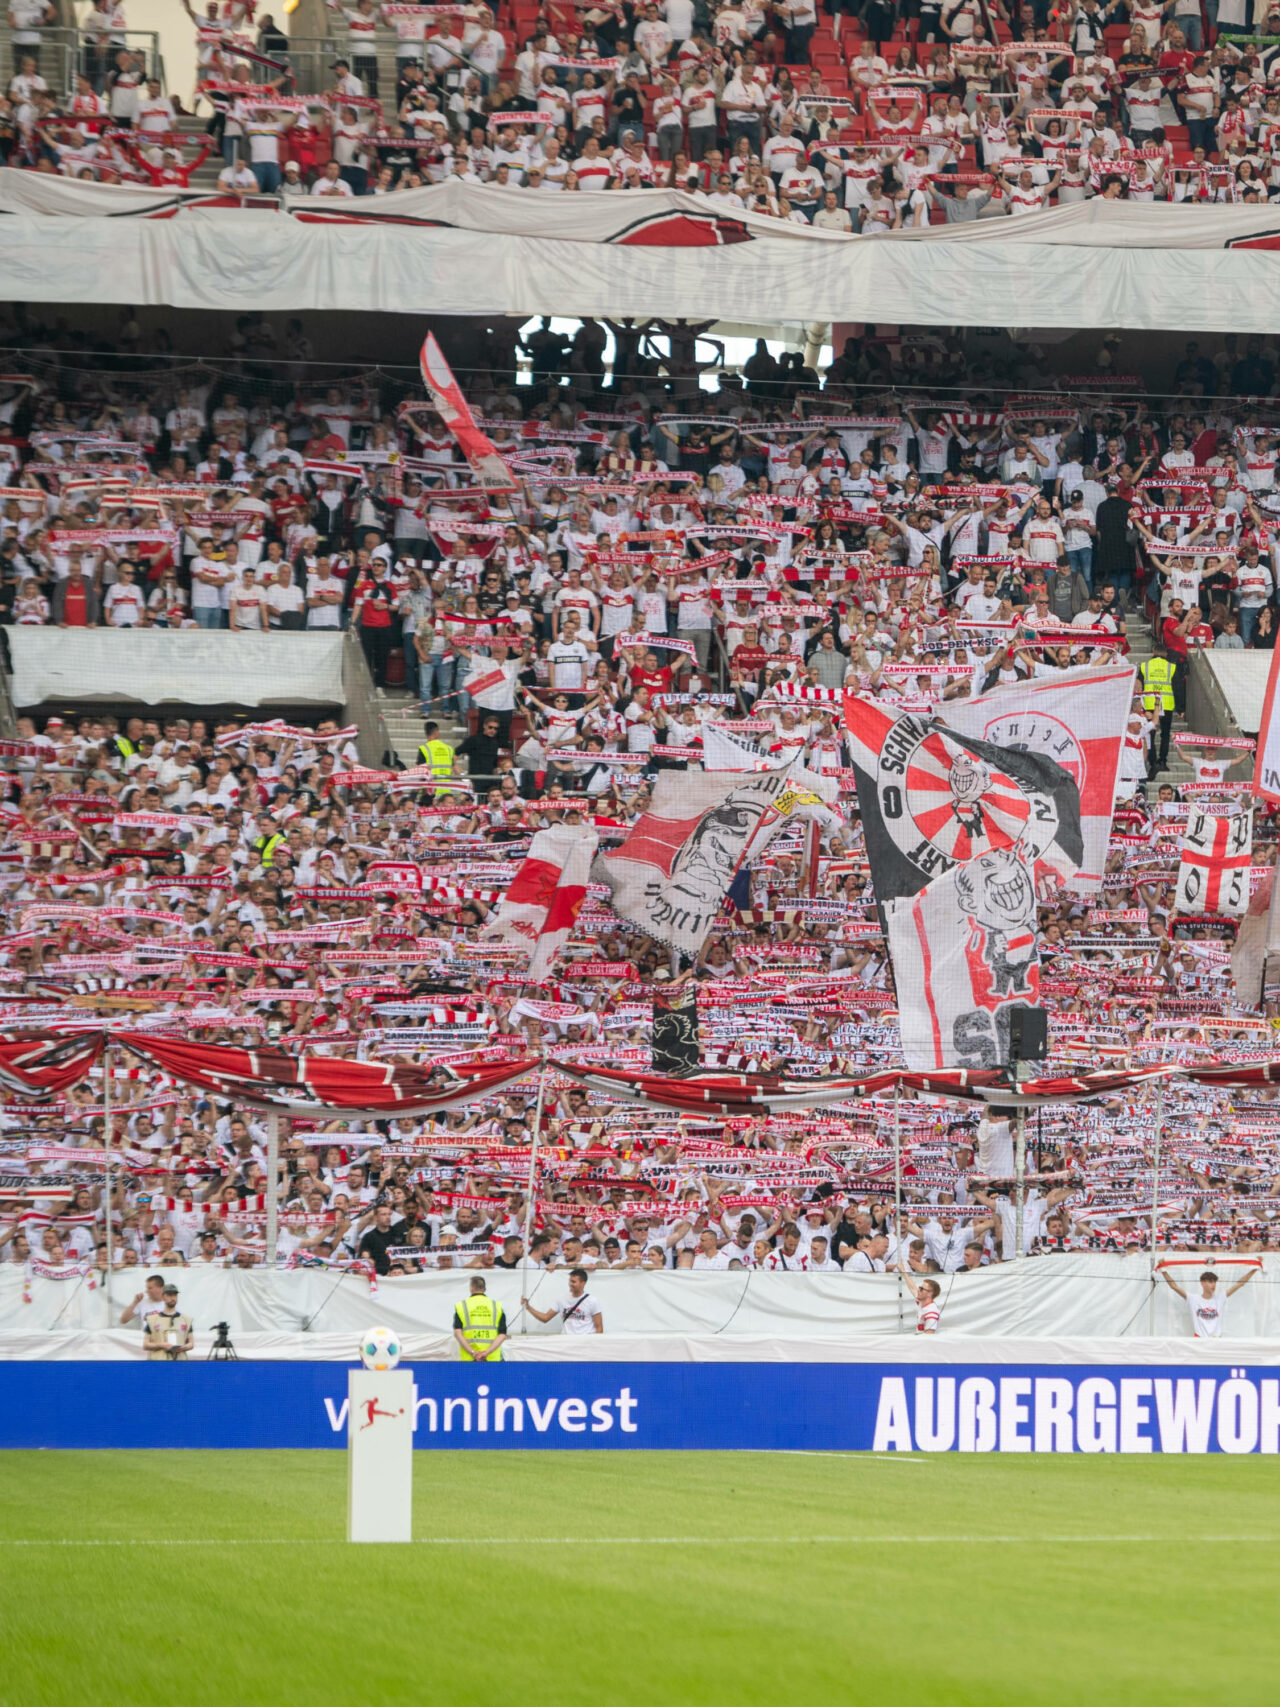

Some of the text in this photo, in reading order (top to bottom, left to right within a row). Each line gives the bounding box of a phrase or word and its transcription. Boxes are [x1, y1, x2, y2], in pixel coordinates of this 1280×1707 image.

[558, 57, 617, 67] STUTTGART
[1159, 505, 1207, 513] STUTTGART
[704, 527, 761, 537] STUTTGART
[921, 637, 1000, 652] TOD DEM KSC
[884, 666, 975, 675] CANNSTATTER KURVE
[615, 753, 648, 762] KURVE
[541, 801, 586, 809] STUTTGART
[1177, 803, 1230, 815] ERSLASSIG
[119, 813, 180, 826] STUTTGART
[384, 1032, 454, 1042] CANNSTATTER
[324, 1384, 638, 1432] whninvest
